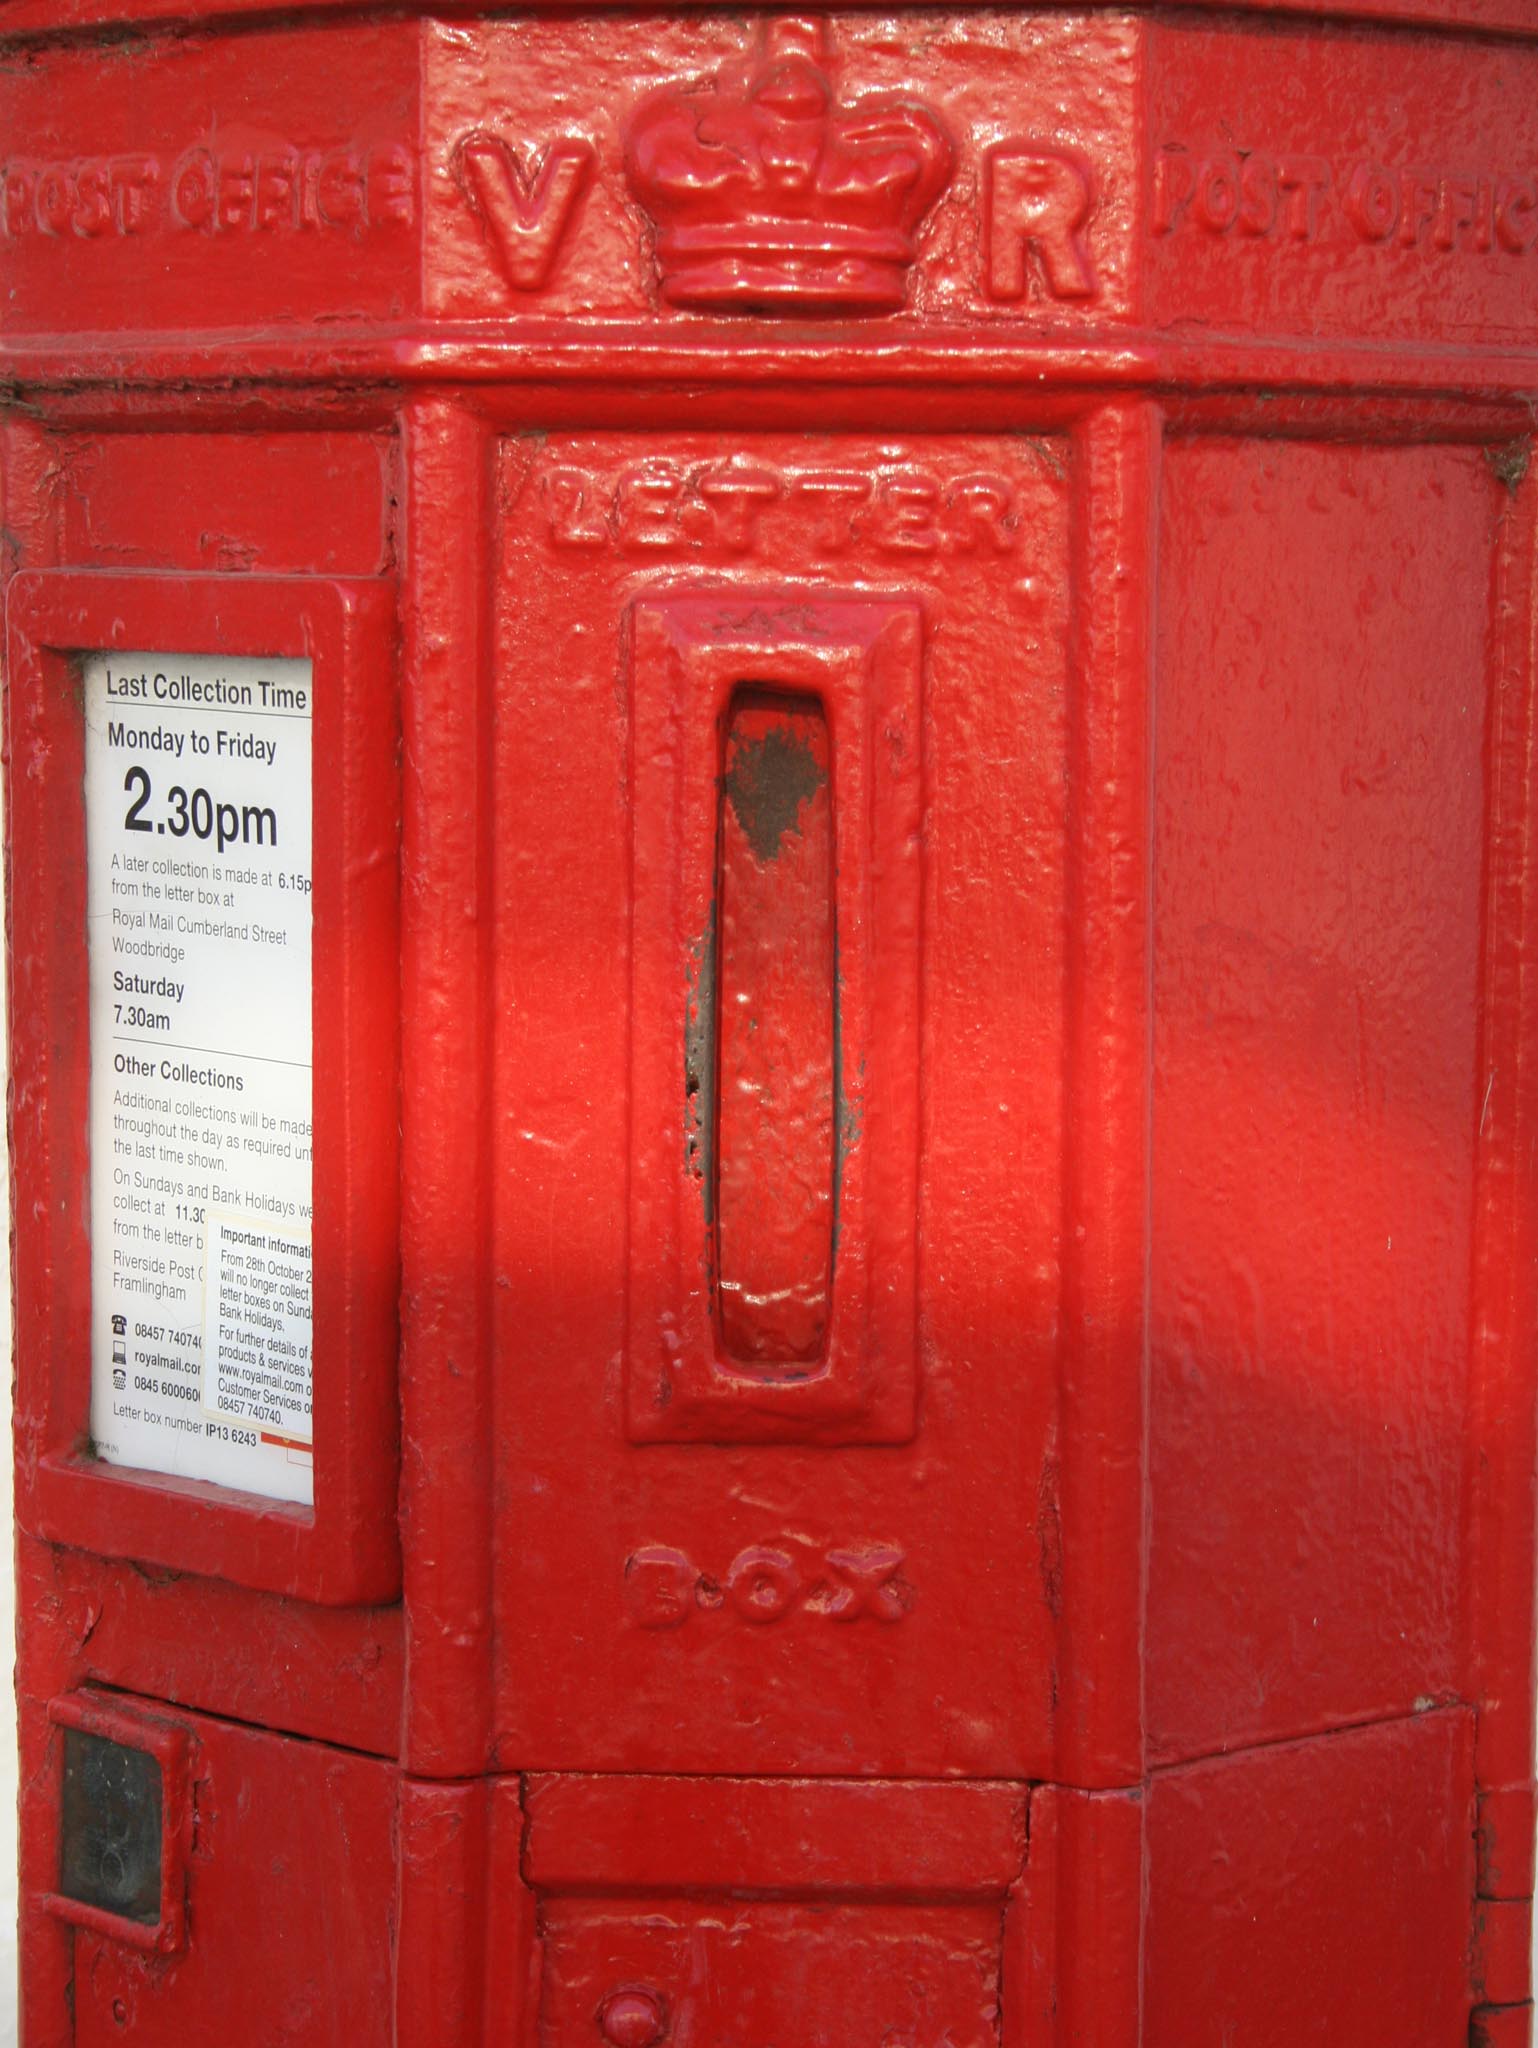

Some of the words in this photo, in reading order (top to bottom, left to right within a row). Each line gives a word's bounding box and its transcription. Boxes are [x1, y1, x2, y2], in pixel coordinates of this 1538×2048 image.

[1151, 148, 1331, 241] POST
[464, 138, 598, 291] V
[985, 150, 1098, 298] R
[542, 458, 1018, 555] LETTER
[106, 670, 148, 698] Last
[154, 673, 252, 705] Collection
[258, 681, 307, 709] Time
[109, 722, 185, 757] Monday
[191, 730, 210, 755] to
[217, 730, 277, 765] Friday
[124, 766, 277, 853] 2.30pm
[111, 853, 120, 870] A
[123, 855, 149, 873] later
[152, 859, 209, 879] collection
[213, 865, 222, 881] is
[225, 866, 258, 885] made
[261, 872, 273, 886] at
[111, 879, 138, 896] from
[142, 882, 162, 900] the
[165, 884, 194, 903] letter
[198, 887, 220, 906] box
[223, 893, 234, 907] at
[113, 909, 146, 929] Royal
[150, 913, 174, 931] Mail
[177, 916, 248, 940] Cumberland
[252, 926, 287, 945] Street
[113, 936, 185, 964] Woodbridge
[113, 970, 184, 1002] Saturday
[114, 1004, 170, 1030] 7.30am
[114, 1054, 156, 1077] Other
[160, 1060, 244, 1091] Collections
[114, 1089, 171, 1113] Additional
[175, 1101, 237, 1124] collections
[240, 1111, 258, 1128] will
[262, 1115, 276, 1130] be
[280, 1118, 313, 1137] made
[114, 1115, 177, 1139] throughout
[180, 1126, 199, 1142] the
[202, 1128, 223, 1149] day
[226, 1135, 240, 1149] as
[243, 1137, 291, 1158] required
[114, 1139, 132, 1154] the
[135, 1142, 156, 1159] last
[159, 1148, 184, 1164] time
[187, 1151, 228, 1172] shown.
[114, 1168, 130, 1185] On
[134, 1172, 184, 1197] Sundays
[187, 1184, 209, 1200] and
[212, 1185, 241, 1206] Bank
[245, 1192, 295, 1218] Holidays
[114, 1195, 151, 1214] collect
[154, 1201, 166, 1216] at
[114, 1218, 139, 1236] from
[143, 1223, 161, 1242] the
[165, 1226, 193, 1247] letter
[220, 1225, 266, 1248] Important
[114, 1250, 166, 1275] Riverside
[169, 1260, 195, 1280] Post
[221, 1249, 244, 1267] From
[246, 1256, 265, 1272] 28th
[268, 1260, 304, 1281] October
[114, 1272, 186, 1300] Framlingham
[220, 1268, 234, 1283] will
[236, 1273, 248, 1286] no
[250, 1274, 278, 1295] longer
[280, 1284, 309, 1301] collect
[220, 1285, 242, 1302] letter
[244, 1290, 271, 1310] boxes
[273, 1300, 284, 1312] on
[219, 1302, 242, 1320] Bank
[135, 1323, 165, 1342] 08457
[219, 1324, 234, 1340] For
[236, 1329, 265, 1348] further
[267, 1338, 297, 1357] details
[299, 1345, 308, 1360] of
[218, 1345, 256, 1365] products
[258, 1353, 265, 1366] &
[268, 1357, 305, 1378] services
[134, 1375, 159, 1393] 0845
[161, 1382, 201, 1402] 600060
[218, 1363, 303, 1395] www.royalmail.com
[218, 1377, 261, 1401] Customer
[263, 1388, 301, 1412] Services
[113, 1401, 141, 1419] Letter
[144, 1408, 162, 1425] box
[165, 1413, 203, 1433] number
[206, 1423, 229, 1443] IP13
[232, 1428, 257, 1447] 6243
[217, 1395, 245, 1414] 08457
[248, 1403, 283, 1425] 740740.
[624, 1545, 914, 1628] BOX
